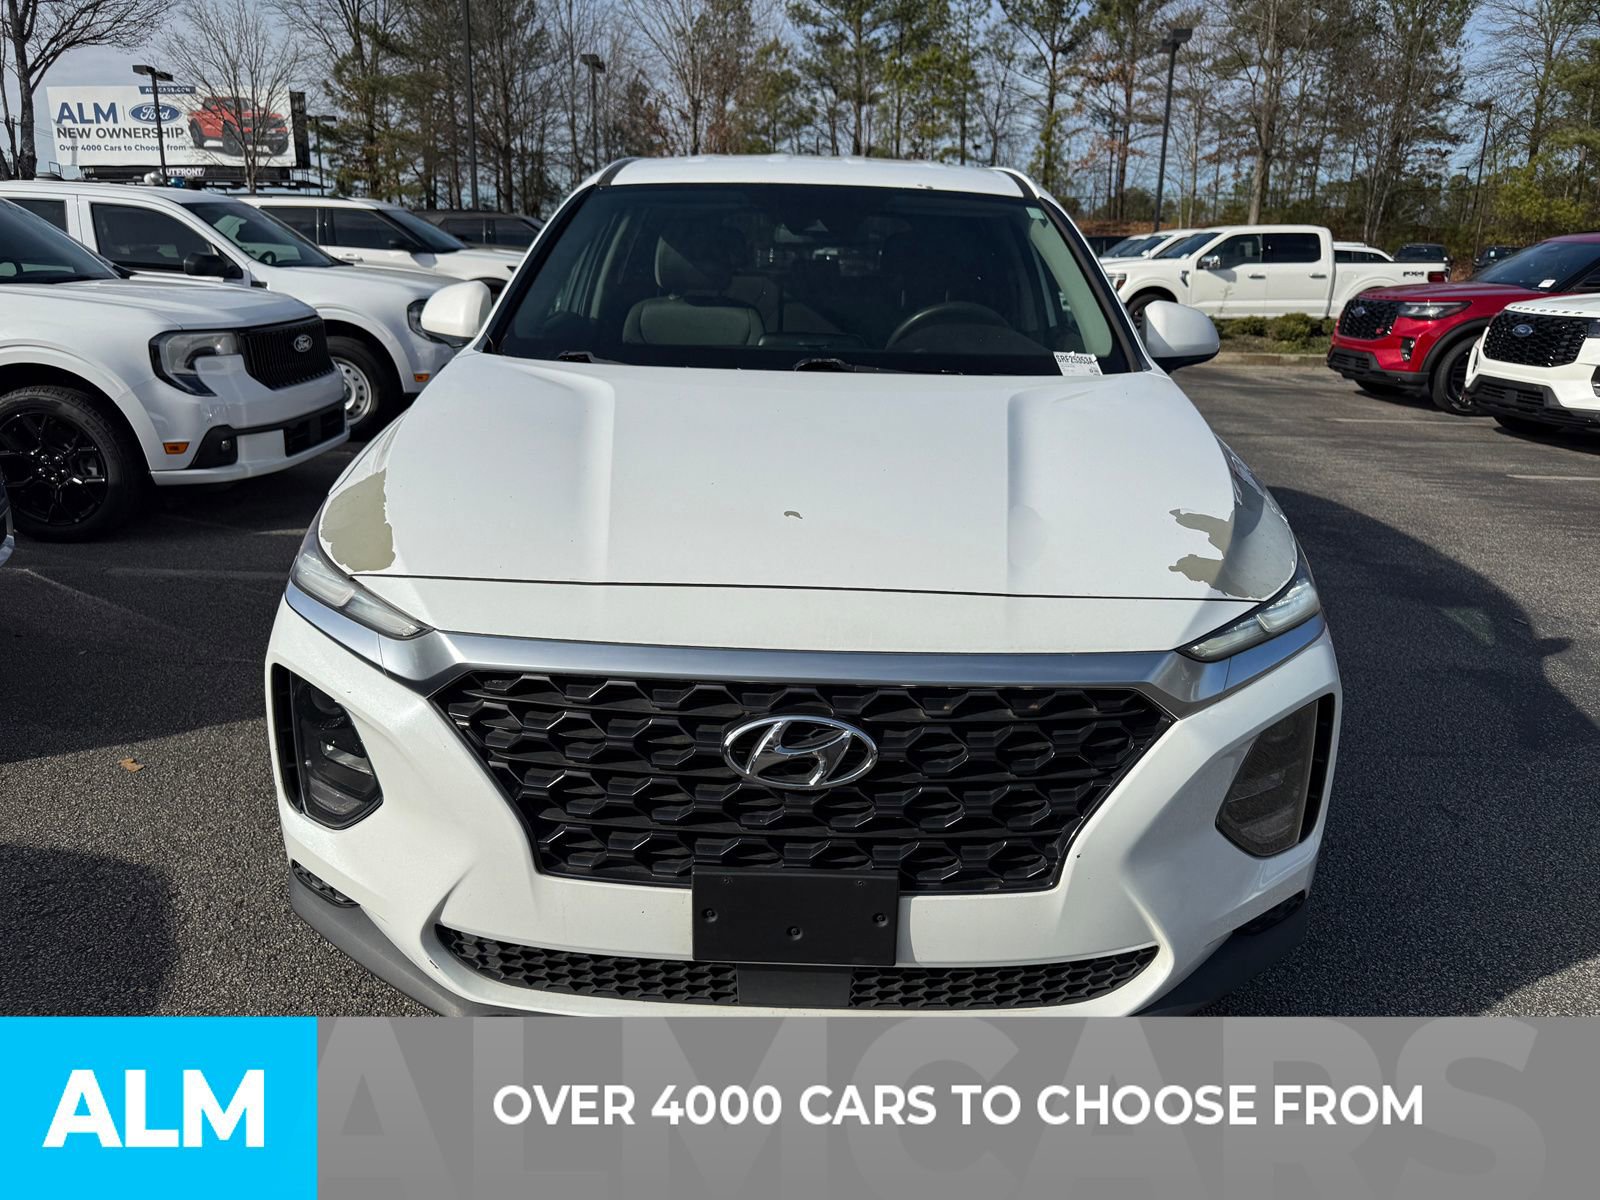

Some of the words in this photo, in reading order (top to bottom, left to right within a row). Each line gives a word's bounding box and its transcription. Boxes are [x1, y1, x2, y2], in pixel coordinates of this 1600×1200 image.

[57, 102, 119, 124] ALM
[57, 128, 91, 139] NEW
[96, 127, 184, 139] OWNERSHIP
